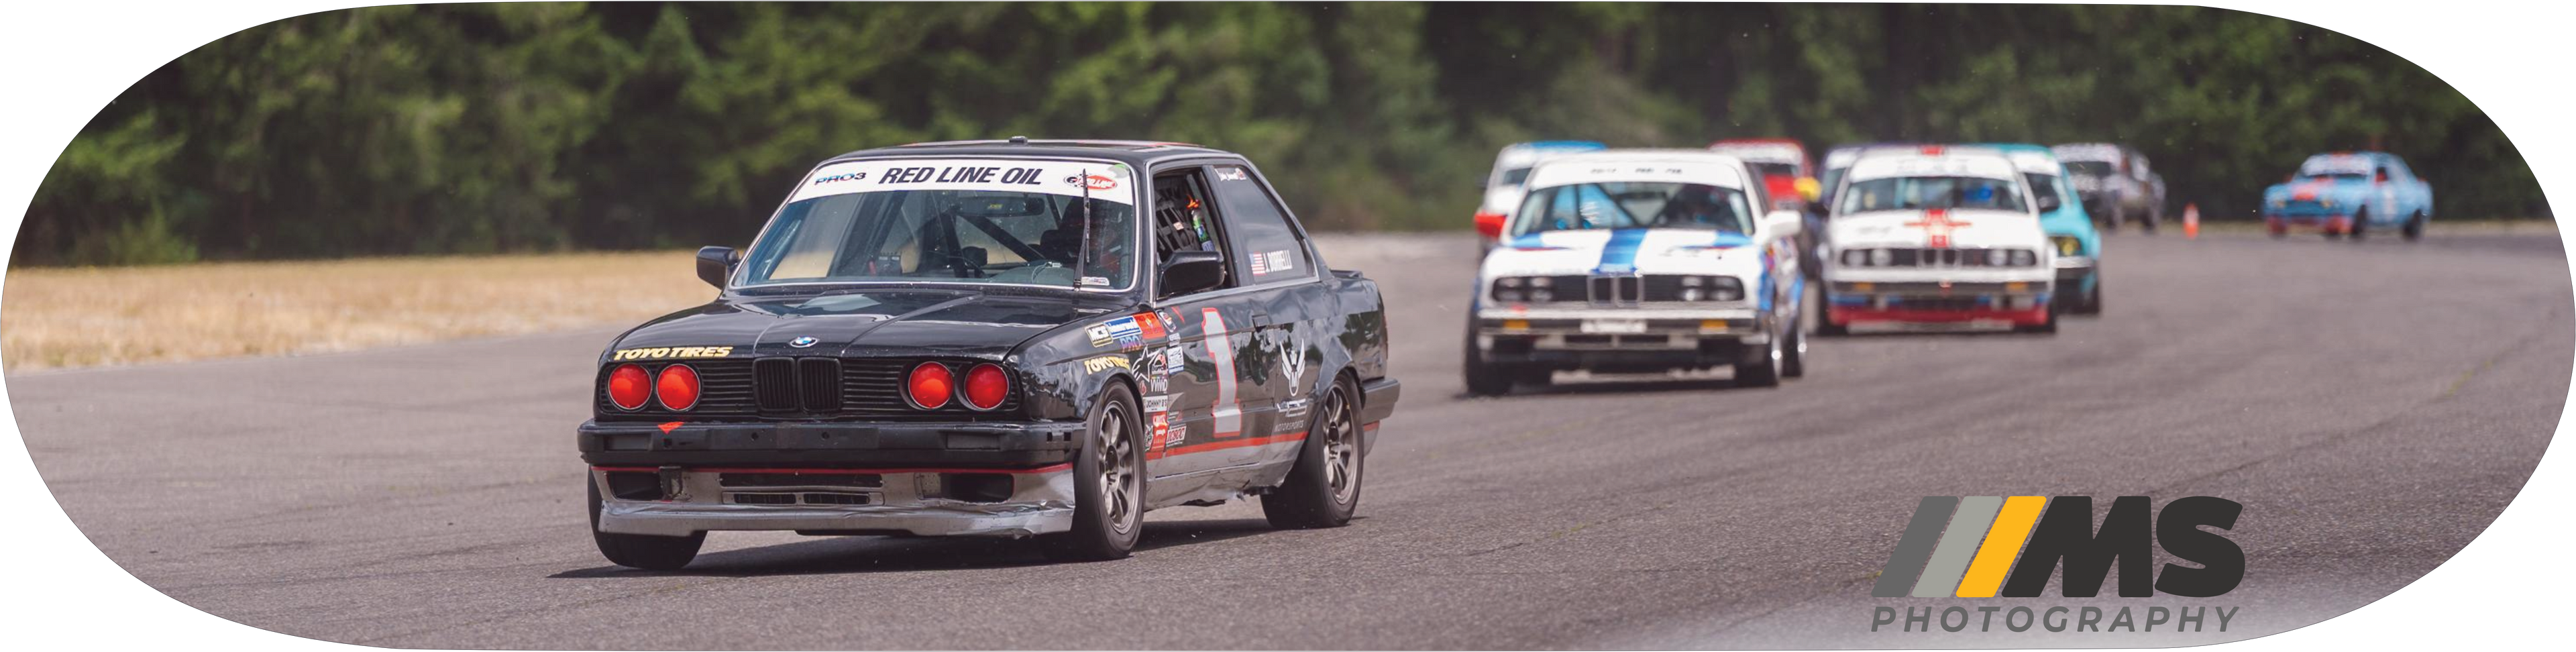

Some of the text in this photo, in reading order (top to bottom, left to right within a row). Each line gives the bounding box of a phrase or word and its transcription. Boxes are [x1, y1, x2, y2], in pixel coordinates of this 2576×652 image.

[814, 172, 866, 185] PRO3
[878, 166, 1043, 184] RED LINE OIL
[614, 346, 733, 360] TOYO TIRES
[1201, 307, 1242, 437] 1
